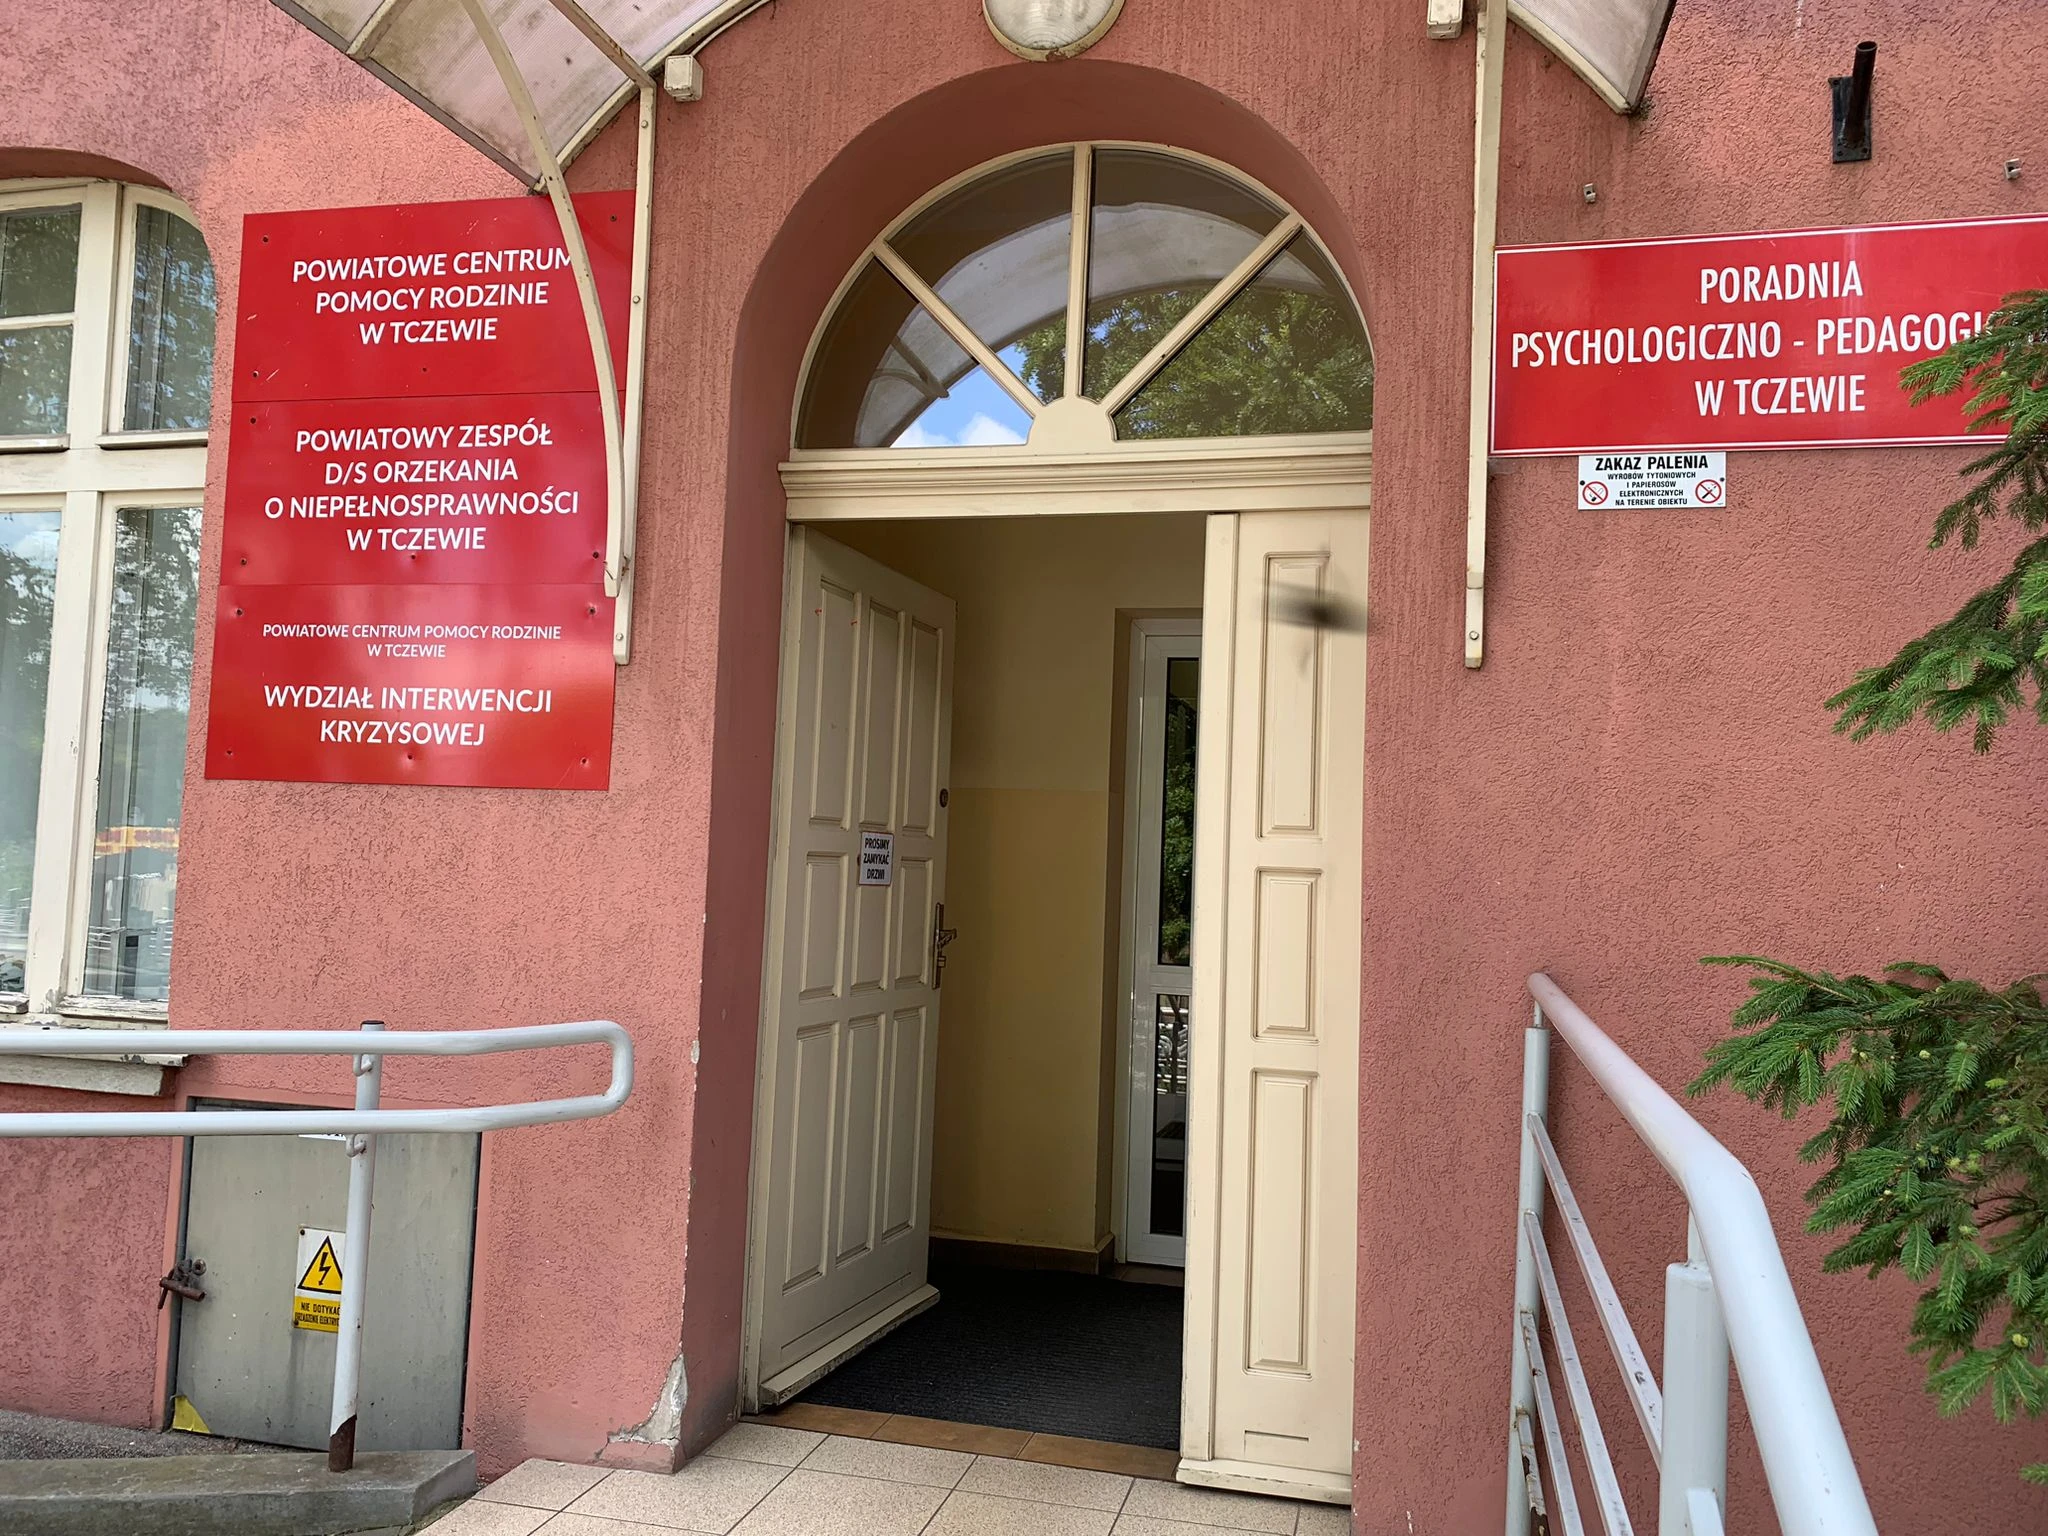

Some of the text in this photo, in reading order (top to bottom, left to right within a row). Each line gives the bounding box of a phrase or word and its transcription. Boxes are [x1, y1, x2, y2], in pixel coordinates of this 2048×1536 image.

[293, 253, 447, 283] POWIATOWE
[1701, 260, 1864, 304] PORADNIA
[316, 282, 549, 314] POMOCY RODZINIE
[359, 318, 498, 345] W TCZEWIE
[1512, 321, 1781, 368] PSYCHOLOGICZNO
[1817, 311, 2004, 356] PEDAGOGI
[1695, 374, 1866, 417] W TCZEWIE
[296, 418, 553, 452] POWIATOWY ZESPÓŁ
[325, 458, 519, 485] D/S ORZEKANIA
[1595, 455, 1708, 471] ZAKAZ PALENIA
[1607, 471, 1696, 480] WYROBÓW TYTONIOWYCH
[1619, 489, 1684, 497] ELEKTRONICZNYCH
[1631, 480, 1677, 488] PAPIEROSÓW
[264, 486, 579, 519] O NIEPEŁNOSPRAWNOŚCI
[346, 527, 487, 551] W TCZEWIE
[263, 624, 562, 640] POWIATOWE CENTRUM POMOCY RODZINIE
[367, 643, 447, 658] W TCZEWIE
[264, 685, 552, 713] WYDZIAŁ INTERWENCJI
[320, 719, 486, 746] KRYZYSOWEJ
[864, 837, 890, 849] PROSIMY
[866, 868, 885, 880] DRZWI
[300, 1302, 310, 1312] NIE
